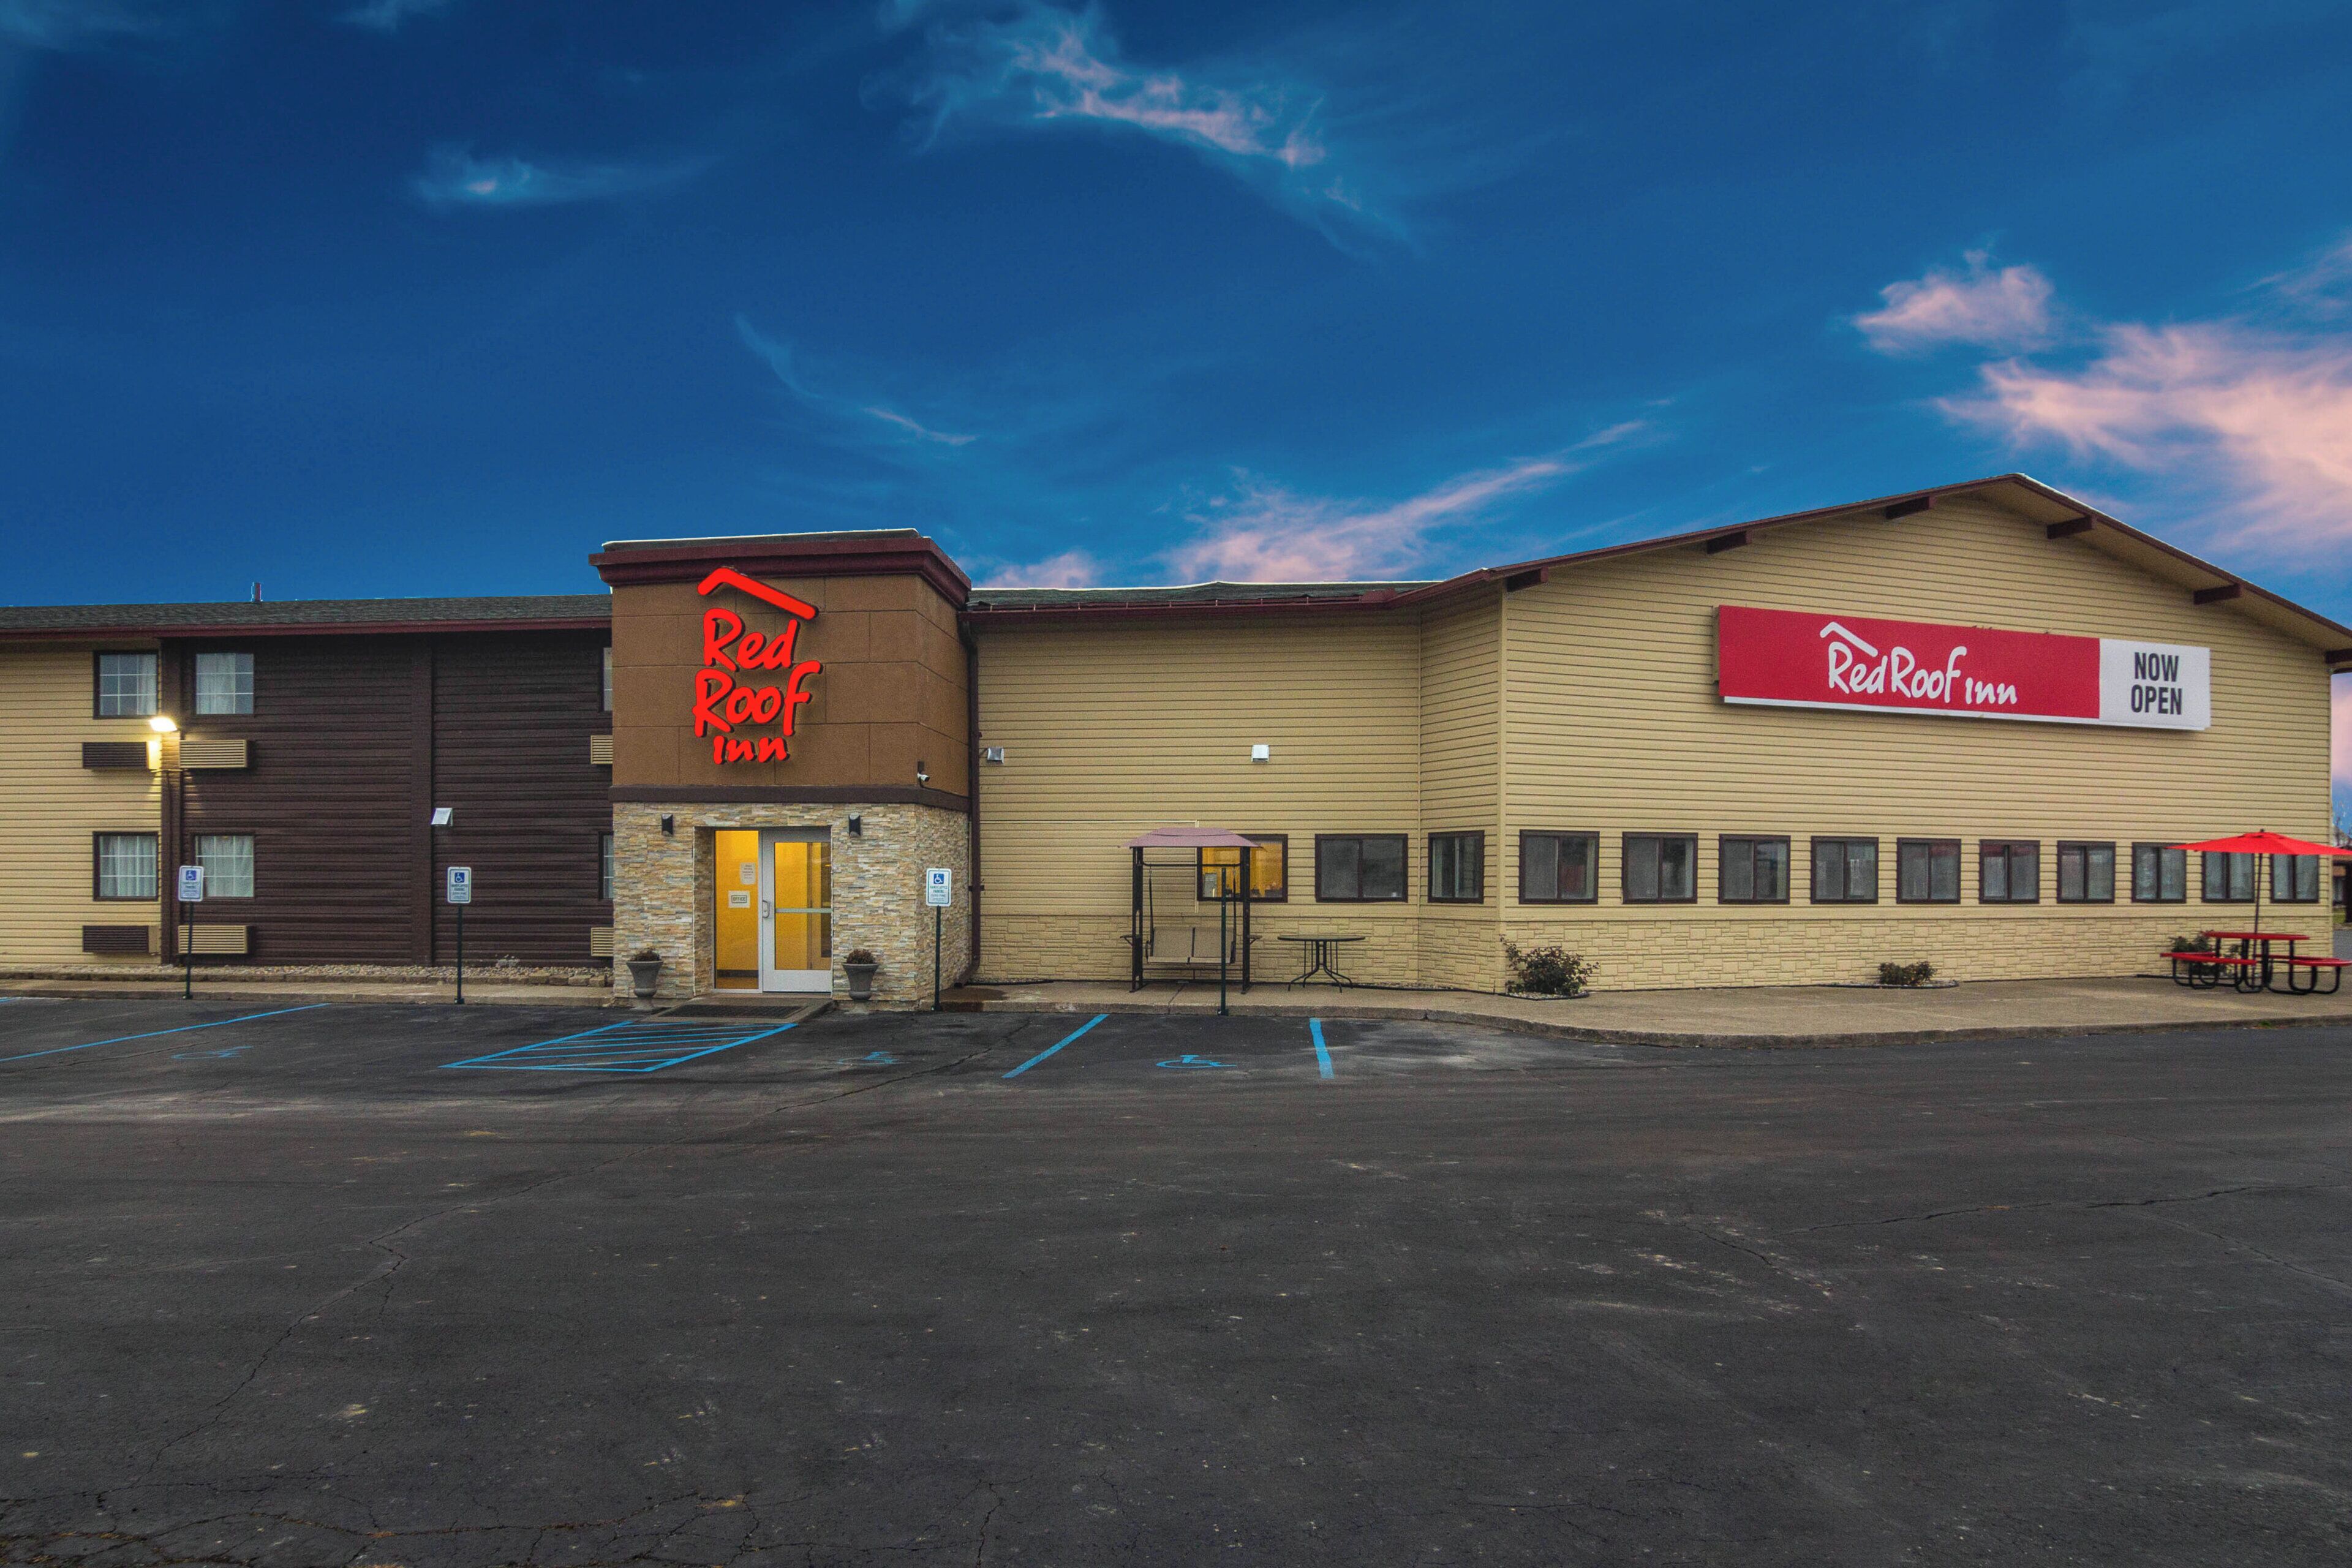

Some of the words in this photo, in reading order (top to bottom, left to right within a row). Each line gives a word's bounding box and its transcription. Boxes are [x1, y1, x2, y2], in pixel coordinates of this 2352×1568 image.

[703, 608, 798, 672] Red
[2134, 652, 2179, 682] NOW
[692, 660, 821, 737] Roof
[2131, 684, 2182, 715] OPEN
